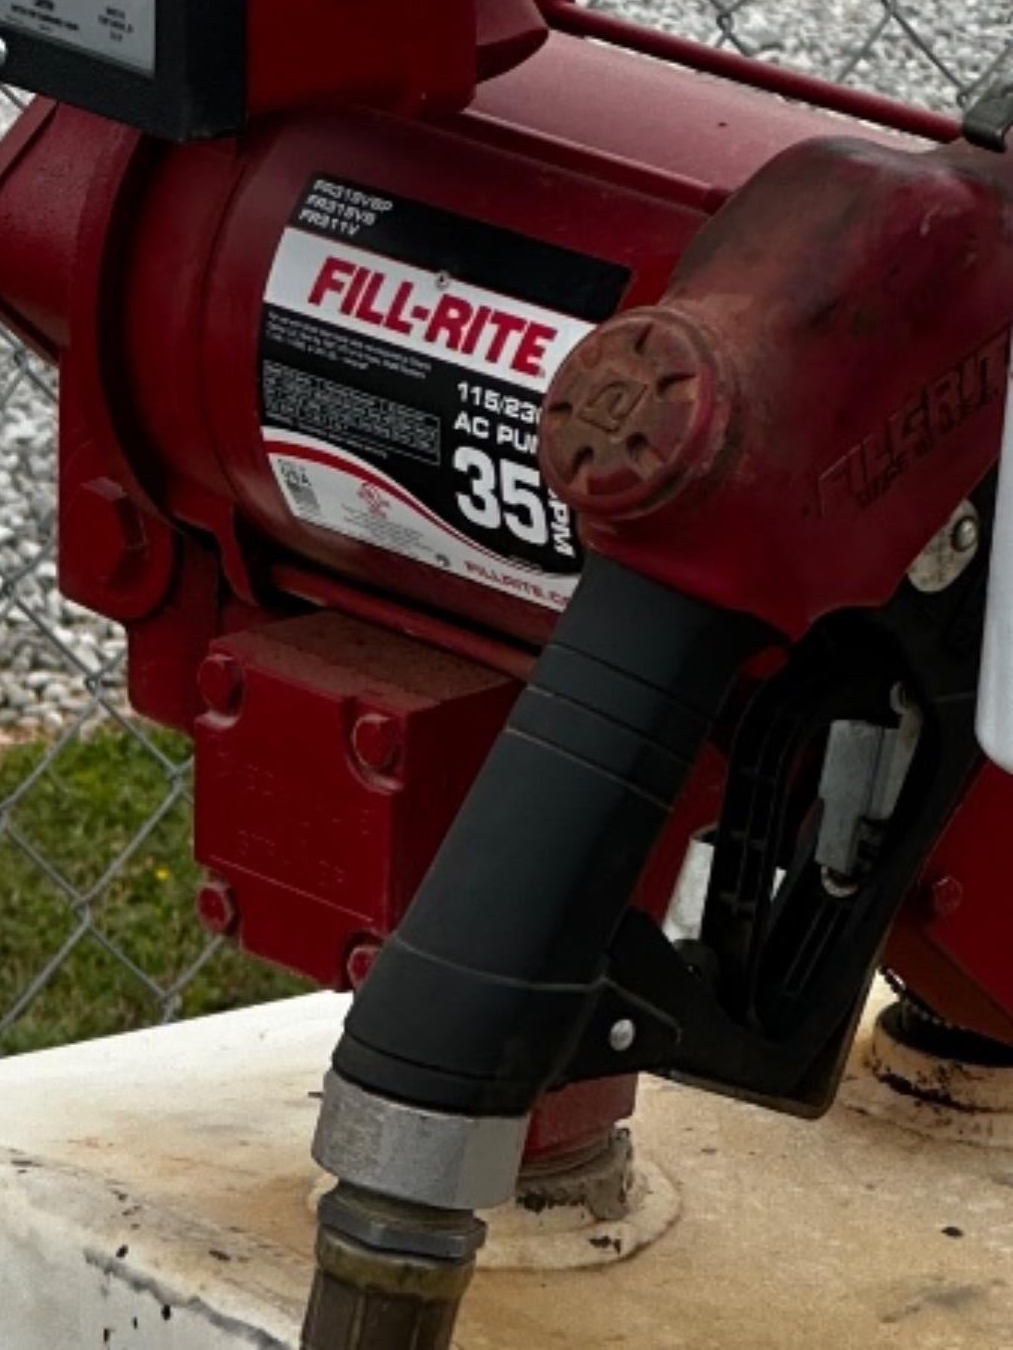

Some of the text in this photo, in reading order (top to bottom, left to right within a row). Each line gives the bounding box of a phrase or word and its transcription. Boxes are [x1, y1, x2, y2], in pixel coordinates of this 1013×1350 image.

[307, 256, 558, 379] FILL-RITE
[454, 411, 489, 438] AC
[454, 446, 549, 546] 35
[547, 488, 576, 558] PM
